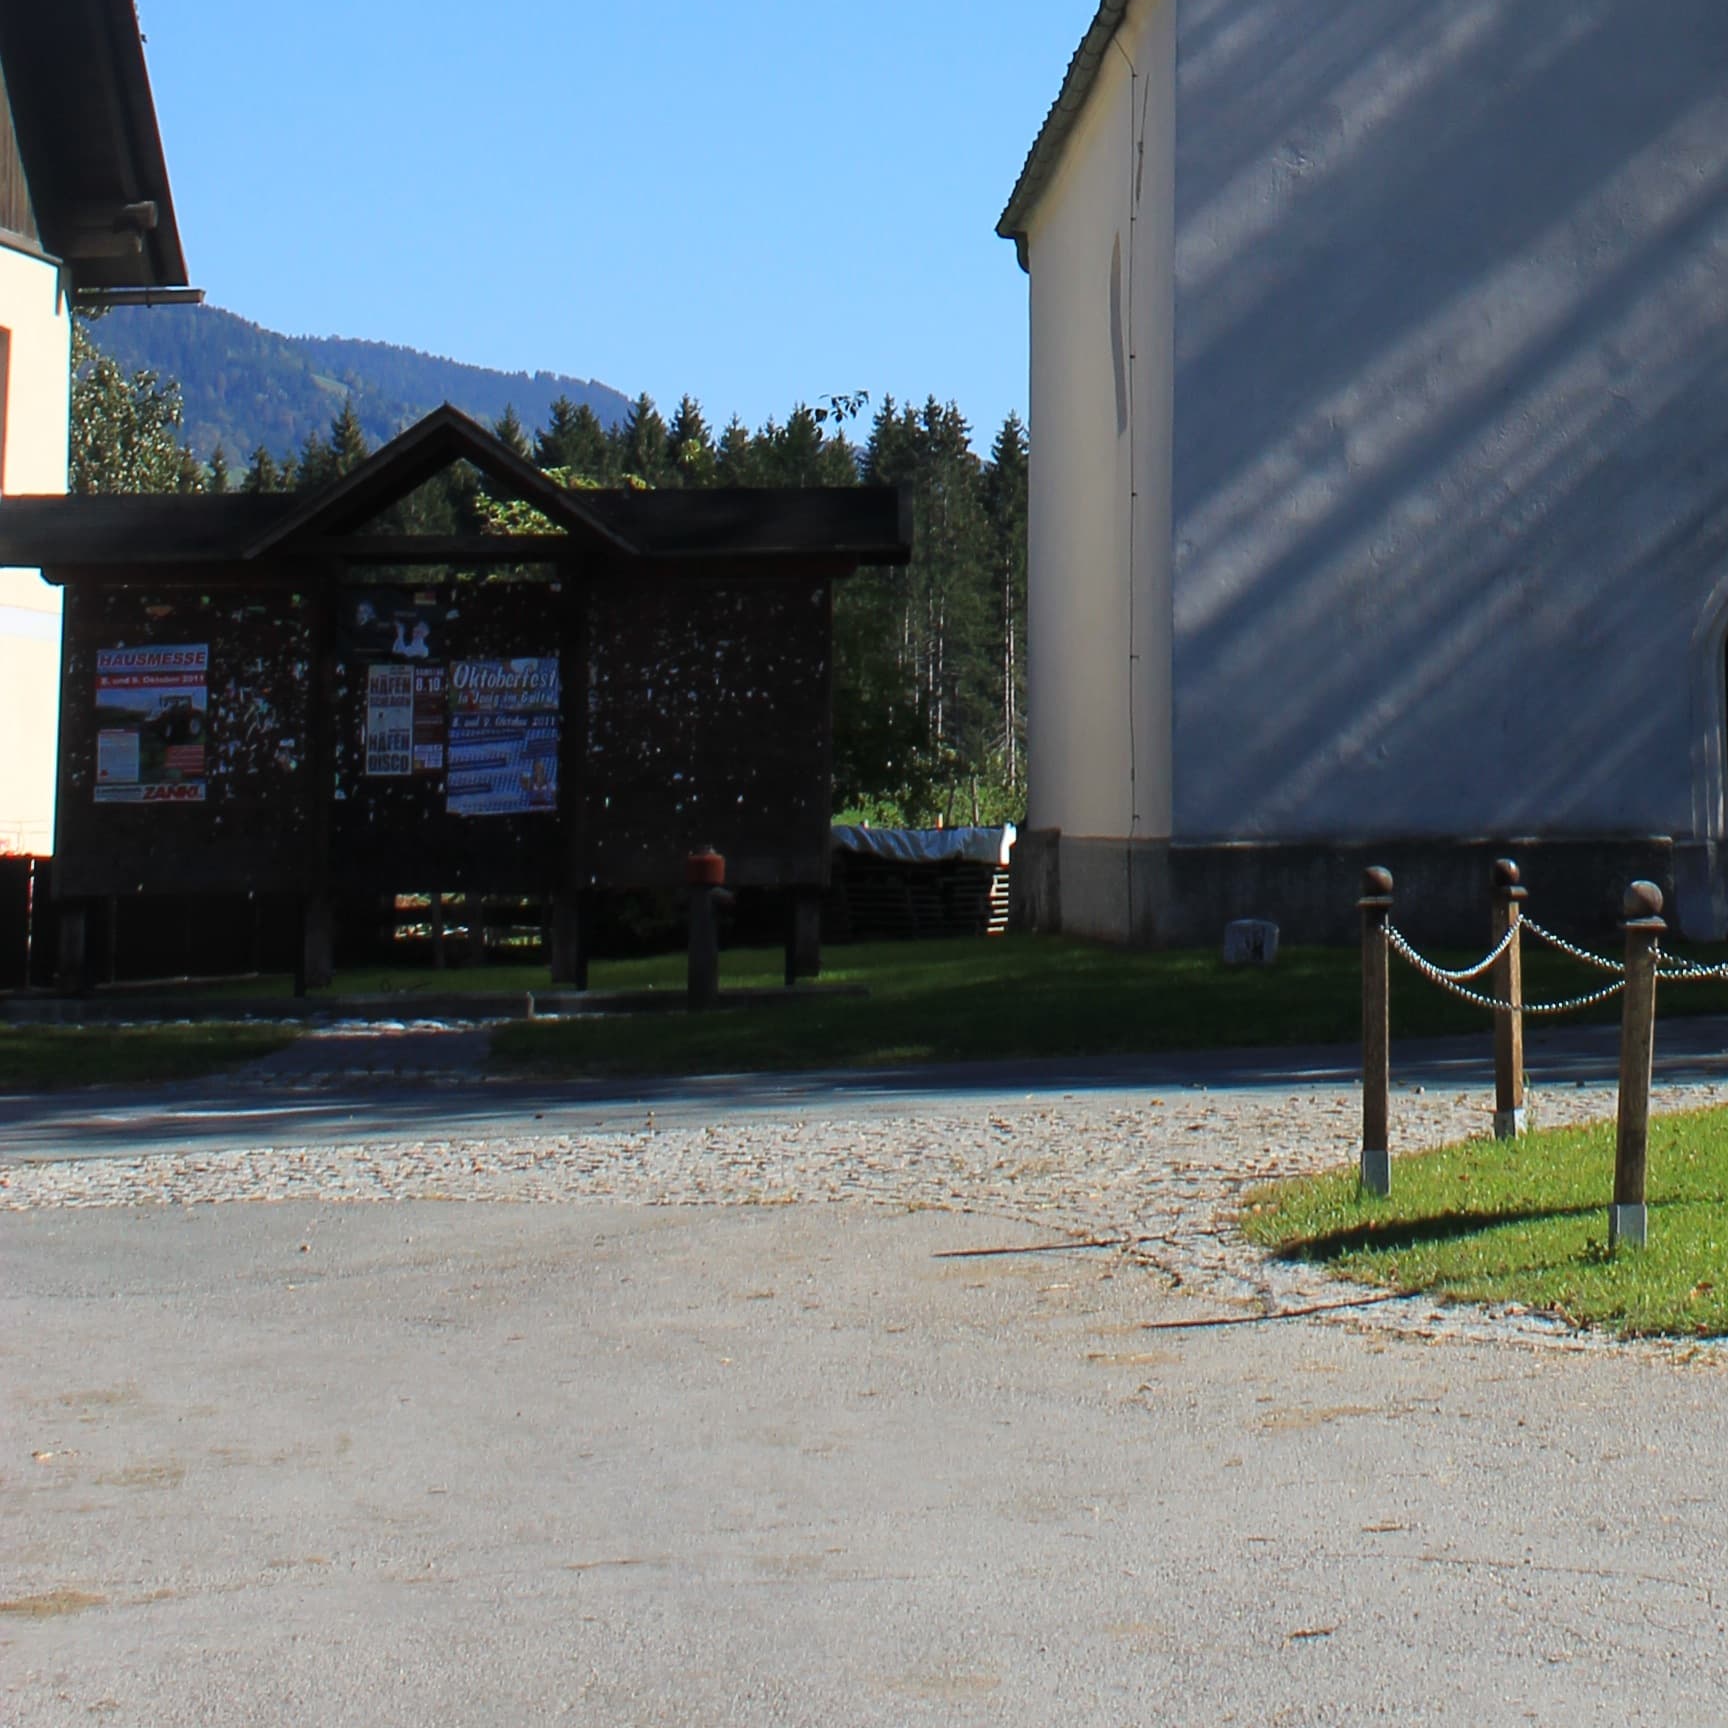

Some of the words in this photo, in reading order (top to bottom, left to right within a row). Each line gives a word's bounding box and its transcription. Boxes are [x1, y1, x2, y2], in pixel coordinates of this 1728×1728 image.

[97, 651, 206, 666] HAUSMESSE
[143, 675, 180, 684] Oktober
[453, 662, 557, 689] Oktoberfest
[368, 754, 409, 772] DISCO
